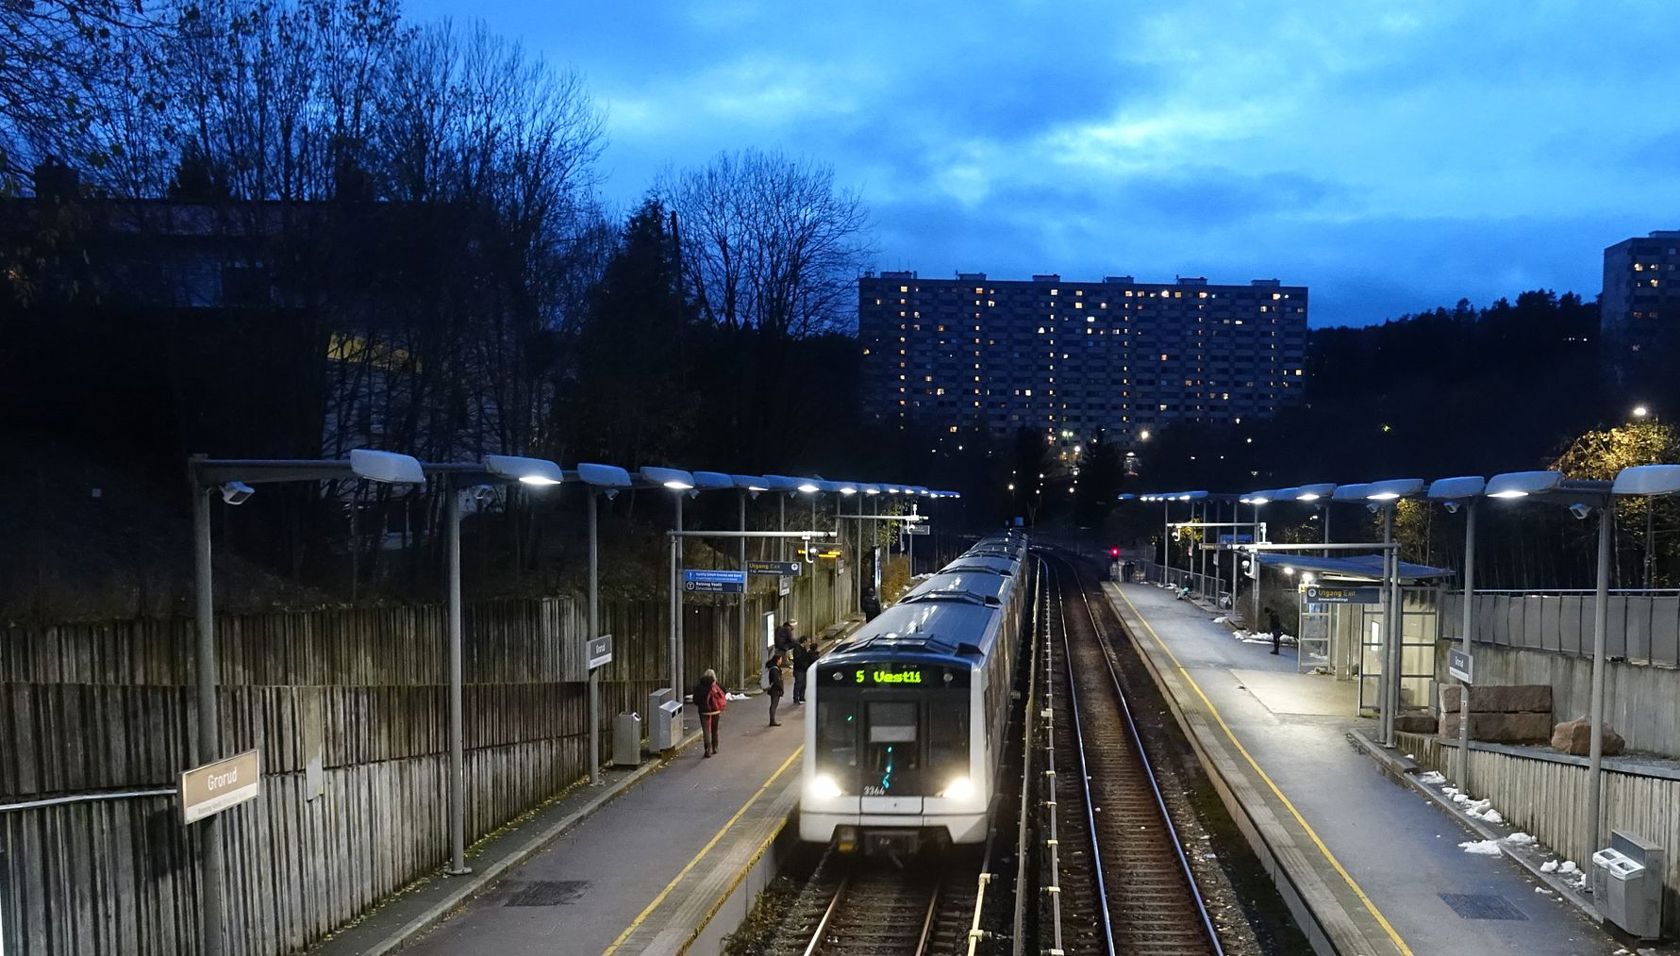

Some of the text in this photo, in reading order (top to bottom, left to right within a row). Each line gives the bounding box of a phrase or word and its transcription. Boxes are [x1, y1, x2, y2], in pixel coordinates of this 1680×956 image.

[856, 670, 922, 683] 5 Vestli
[207, 766, 238, 791] Grorud
